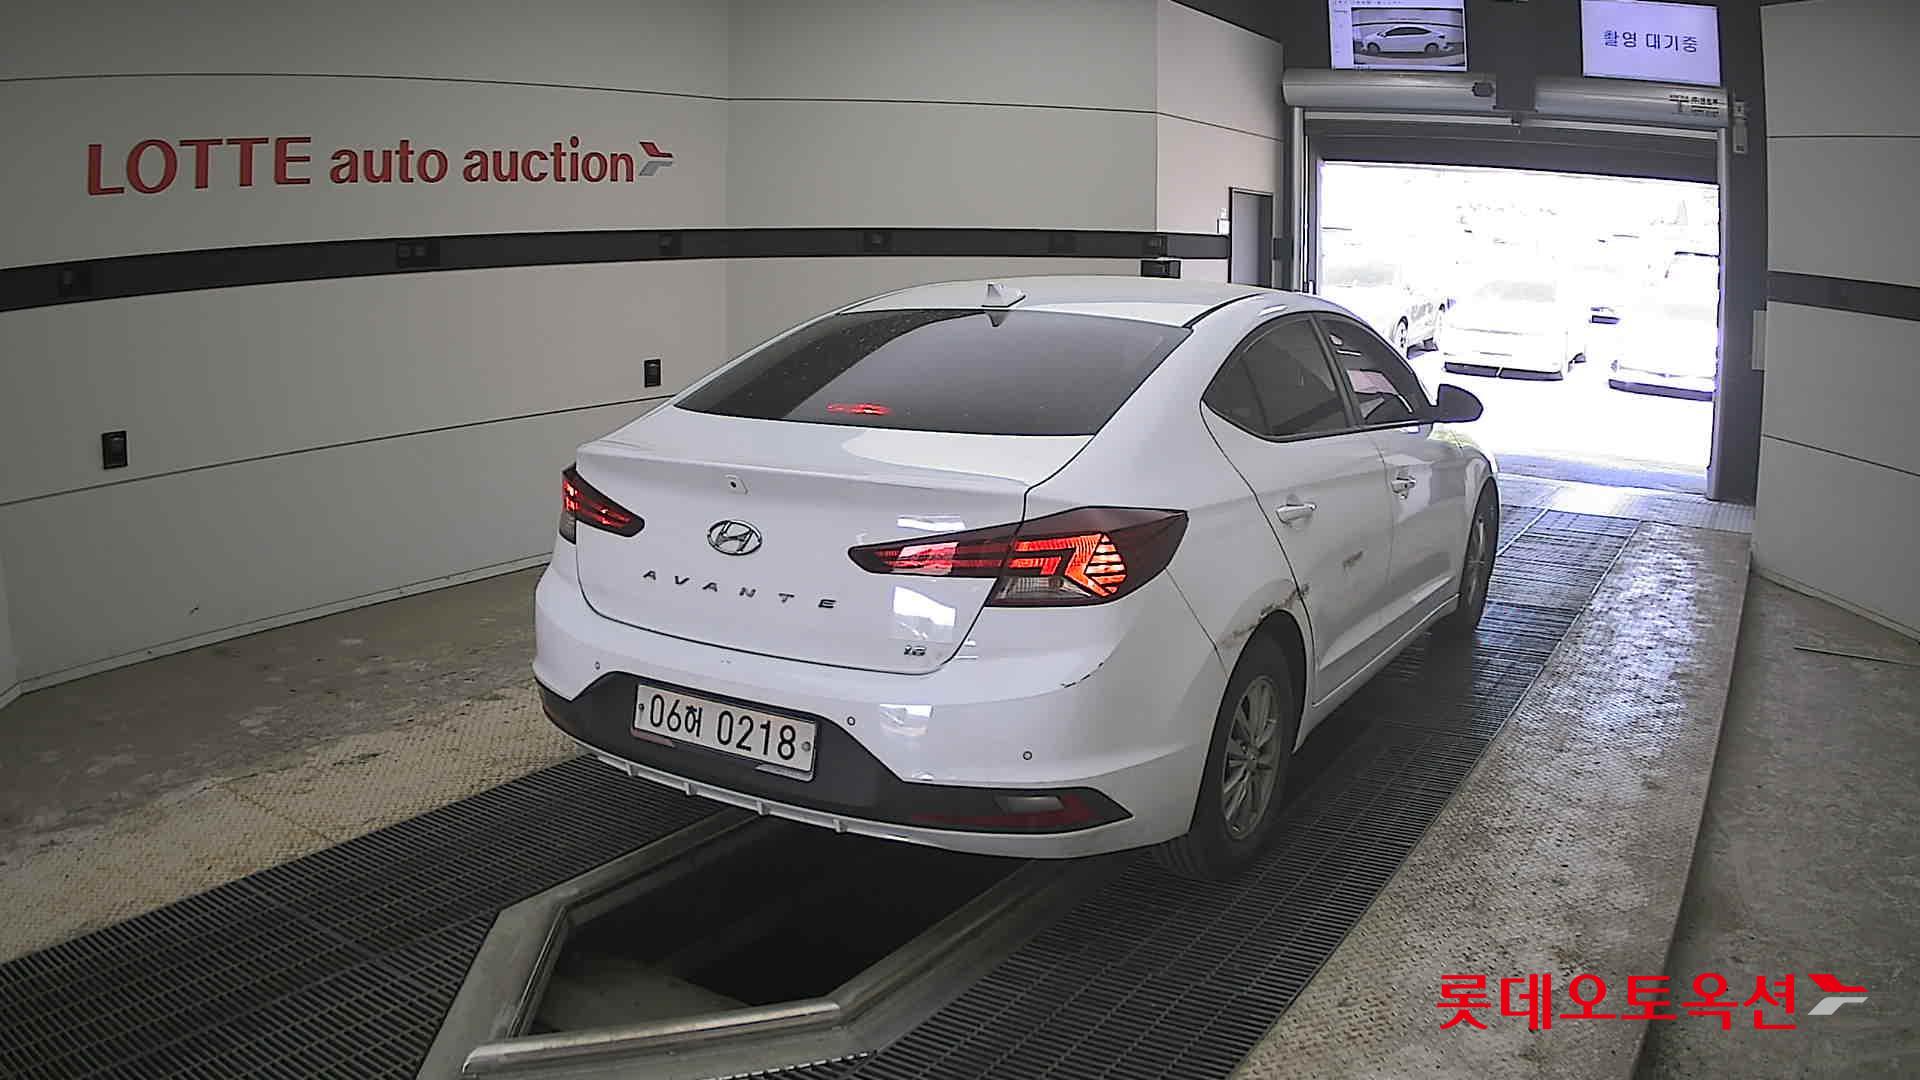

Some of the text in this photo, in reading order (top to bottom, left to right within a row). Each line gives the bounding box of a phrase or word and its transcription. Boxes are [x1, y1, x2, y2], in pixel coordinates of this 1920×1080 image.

[1603, 30, 1698, 53] 촬영 대기중
[87, 136, 635, 196] LOTTE auto auction
[642, 569, 838, 610] AVANTE
[649, 693, 797, 761] 06허 0218
